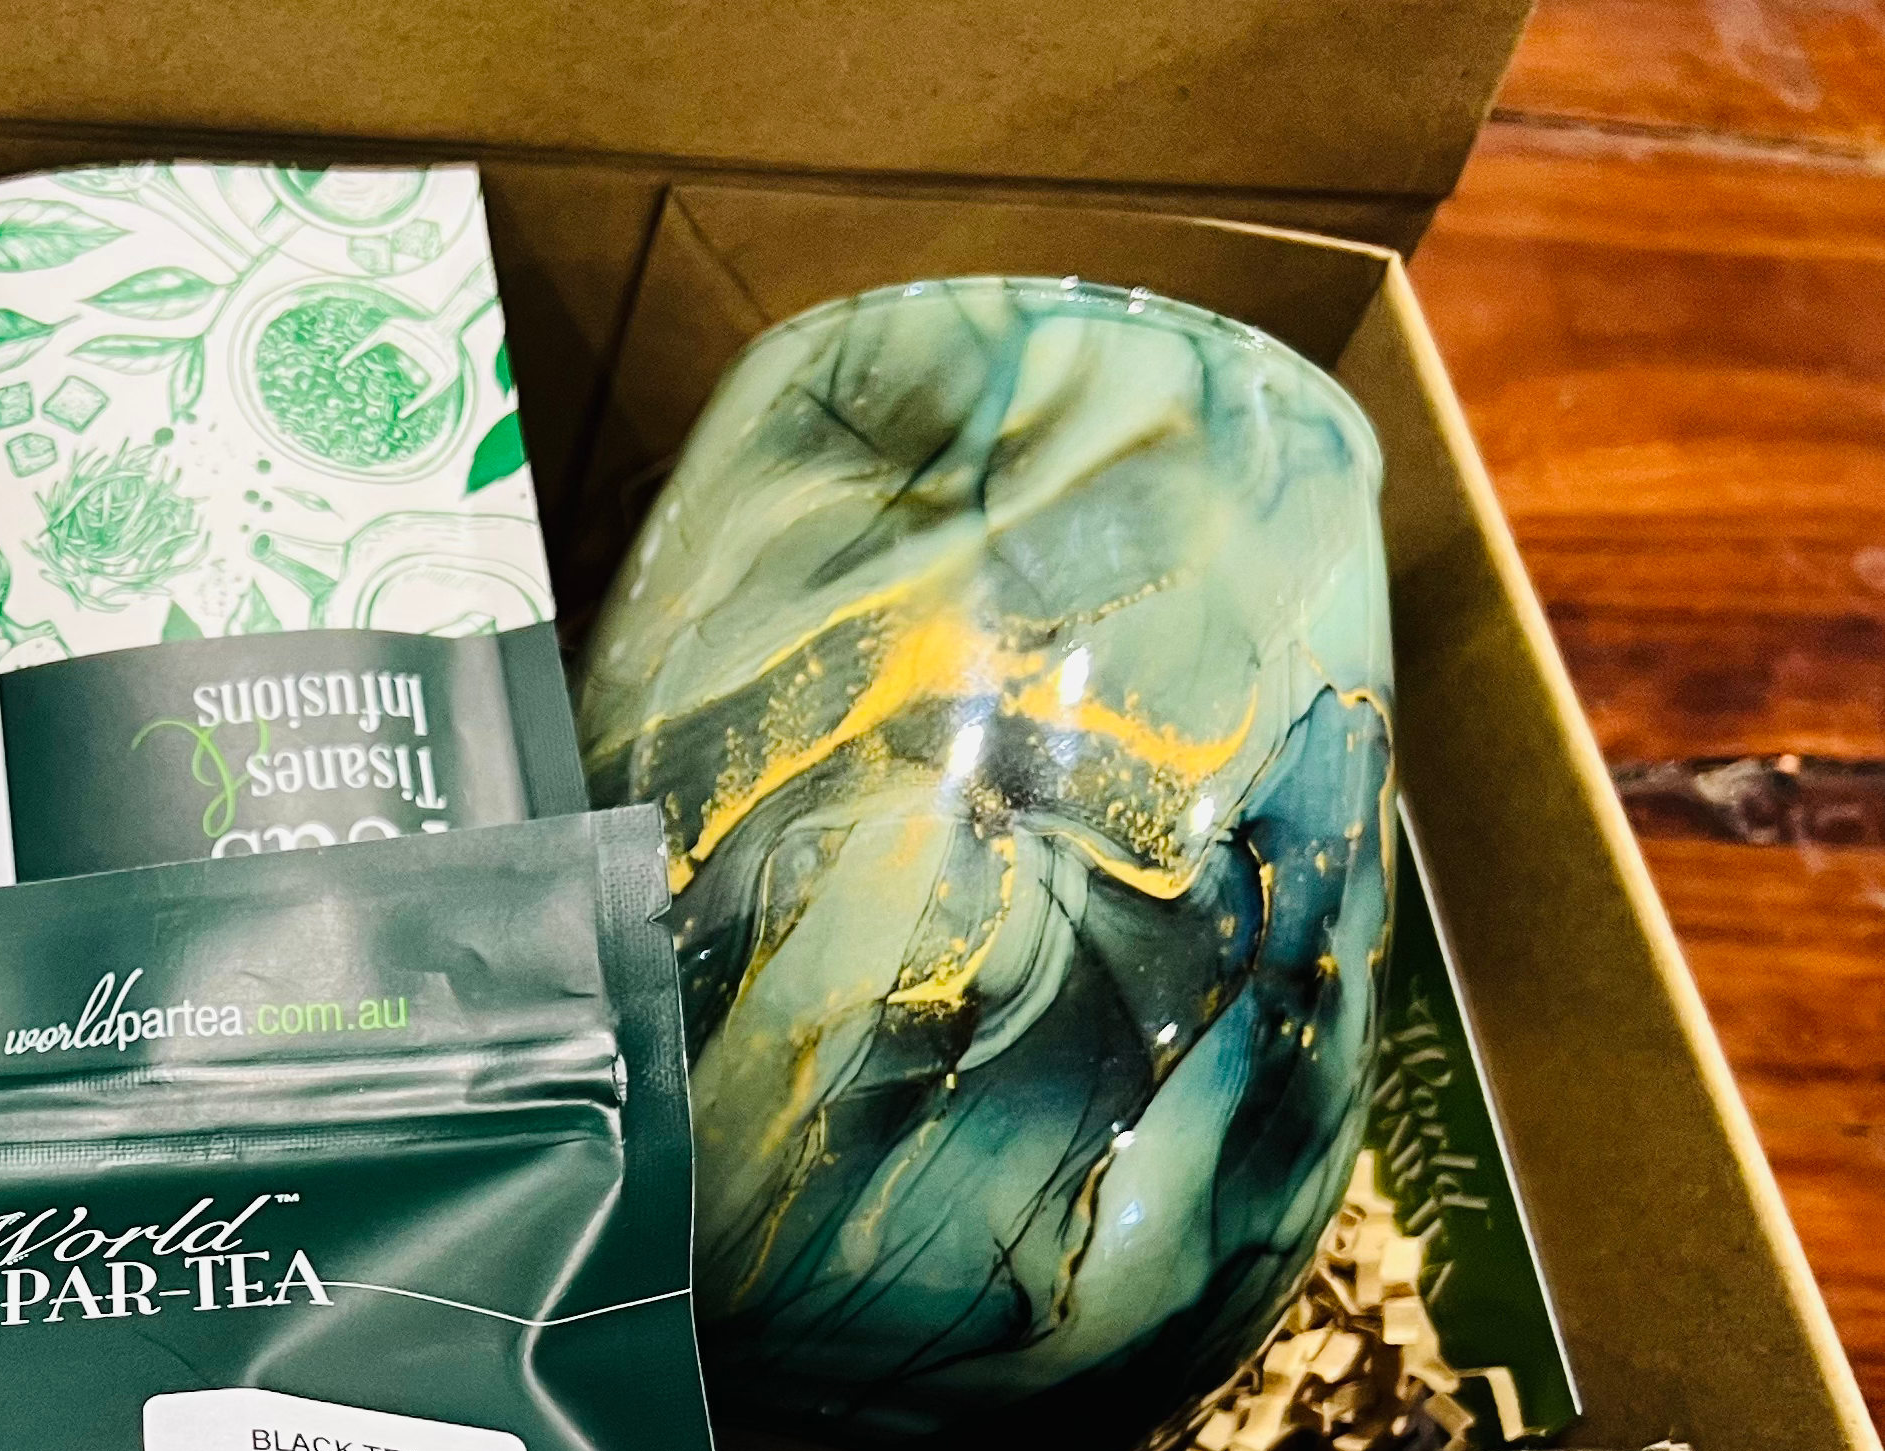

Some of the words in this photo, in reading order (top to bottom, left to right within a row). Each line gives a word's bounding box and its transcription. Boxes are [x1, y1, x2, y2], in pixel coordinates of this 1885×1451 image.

[192, 670, 428, 736] Infusions
[245, 745, 448, 810] Tisanes
[4, 967, 409, 1056] worldpartea.com.au
[0, 1250, 334, 1327] PAR-TEA
